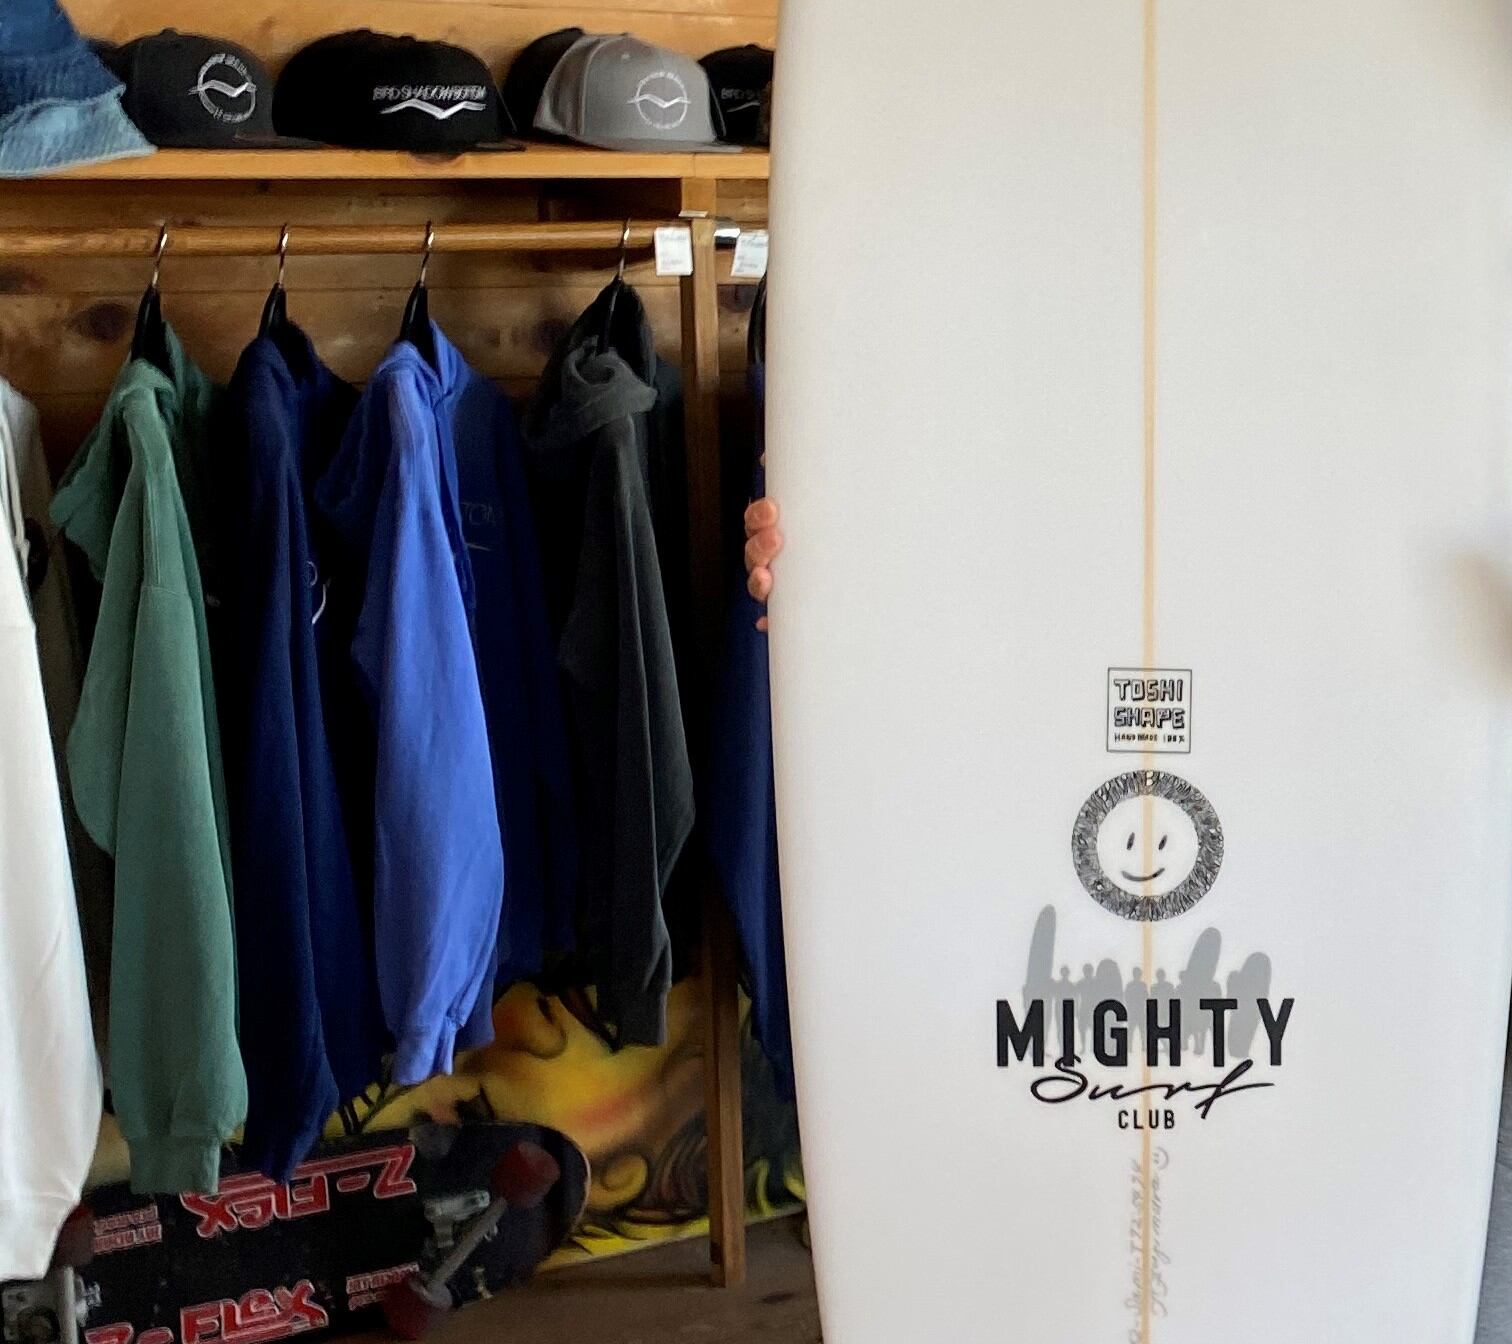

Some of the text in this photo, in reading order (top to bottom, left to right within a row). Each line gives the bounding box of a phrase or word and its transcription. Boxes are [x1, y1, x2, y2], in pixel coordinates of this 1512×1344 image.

[1113, 678, 1184, 702] TOSHI
[1113, 706, 1186, 730] SHAPE
[996, 997, 1295, 1068] MIGHTY
[1030, 1053, 1275, 1120] Surf
[1117, 1109, 1176, 1130] CLUB
